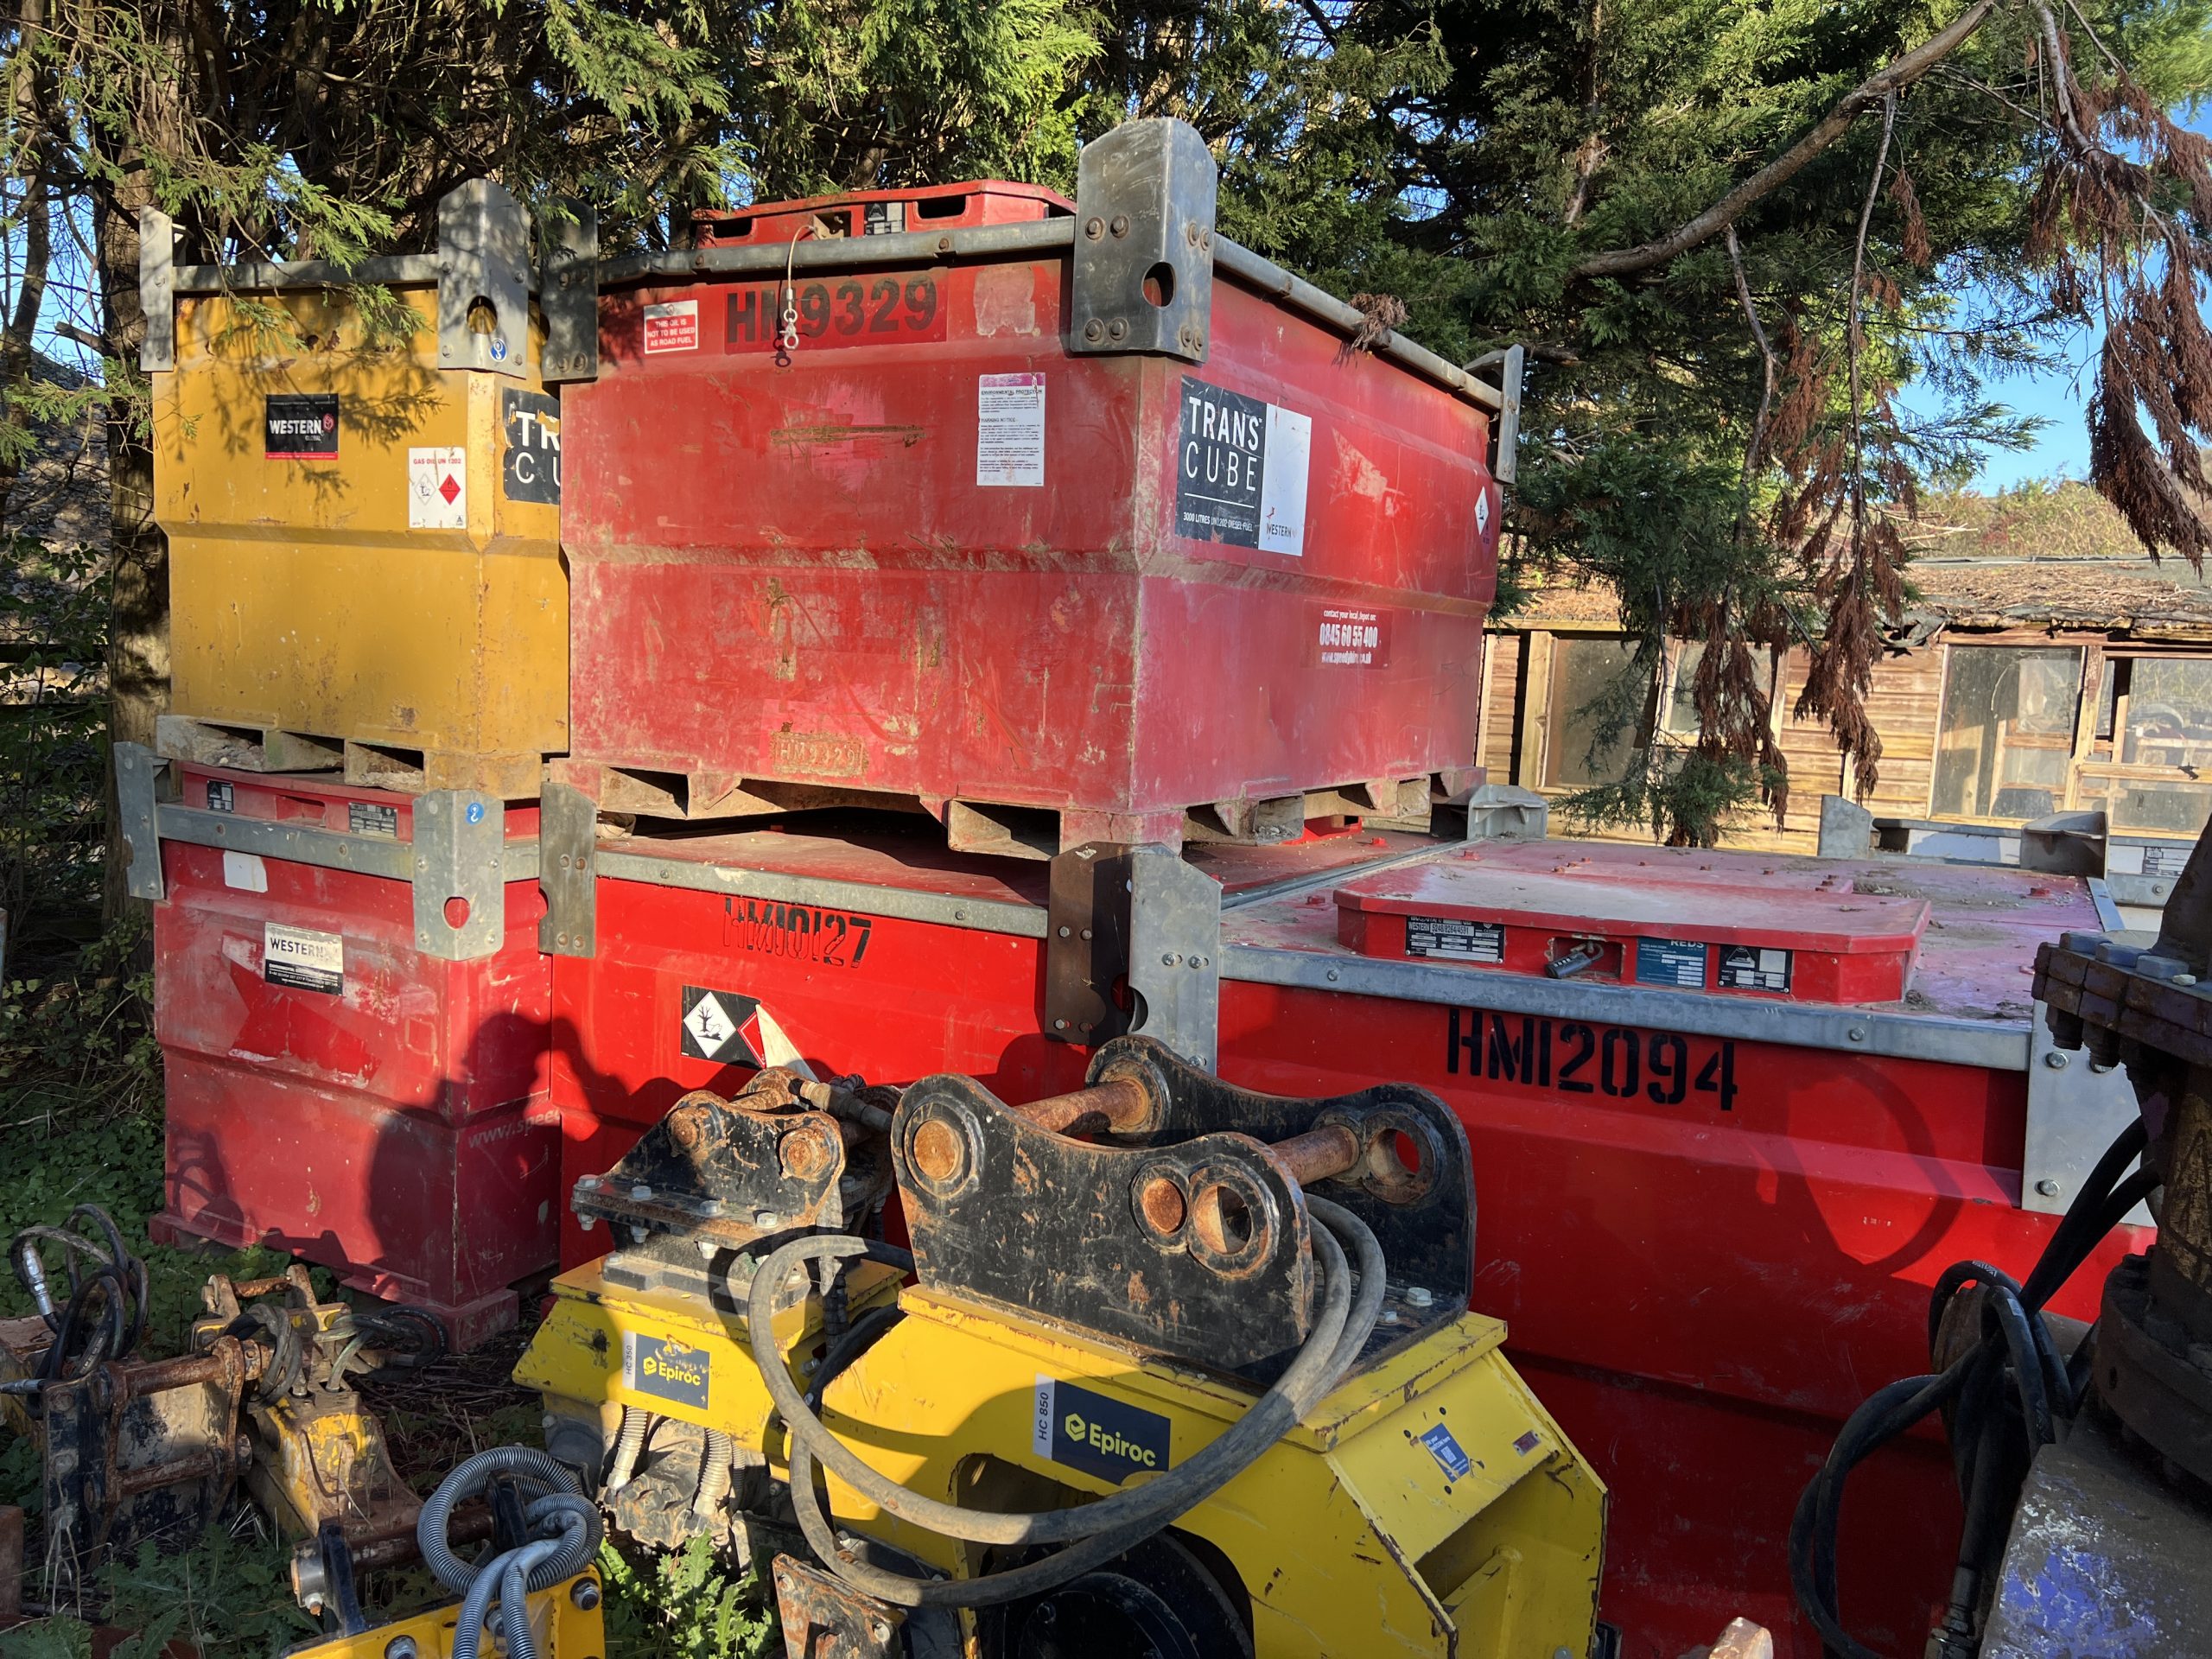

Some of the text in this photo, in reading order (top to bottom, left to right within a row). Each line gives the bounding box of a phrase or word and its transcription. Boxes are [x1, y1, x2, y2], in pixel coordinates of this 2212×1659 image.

[727, 275, 937, 343] HM9329
[269, 420, 322, 435] WESTERN
[1189, 396, 1259, 451] TRANS
[1186, 442, 1258, 491] CUBE
[1183, 512, 1195, 522] 3000
[1195, 513, 1211, 525] LITRES
[1227, 519, 1243, 531] DIESEL
[1243, 522, 1253, 532] FUEL
[1266, 522, 1292, 537] WESTERN
[1339, 611, 1349, 620] your
[1319, 622, 1378, 648] 0845 60 55 400
[1408, 921, 1429, 931] WESTERN
[270, 938, 324, 957] WESTERN
[626, 1362, 632, 1375] HC
[658, 1362, 701, 1386] Epiroc
[1039, 1392, 1049, 1440] HC 850
[1090, 1422, 1156, 1466] Epiroc
